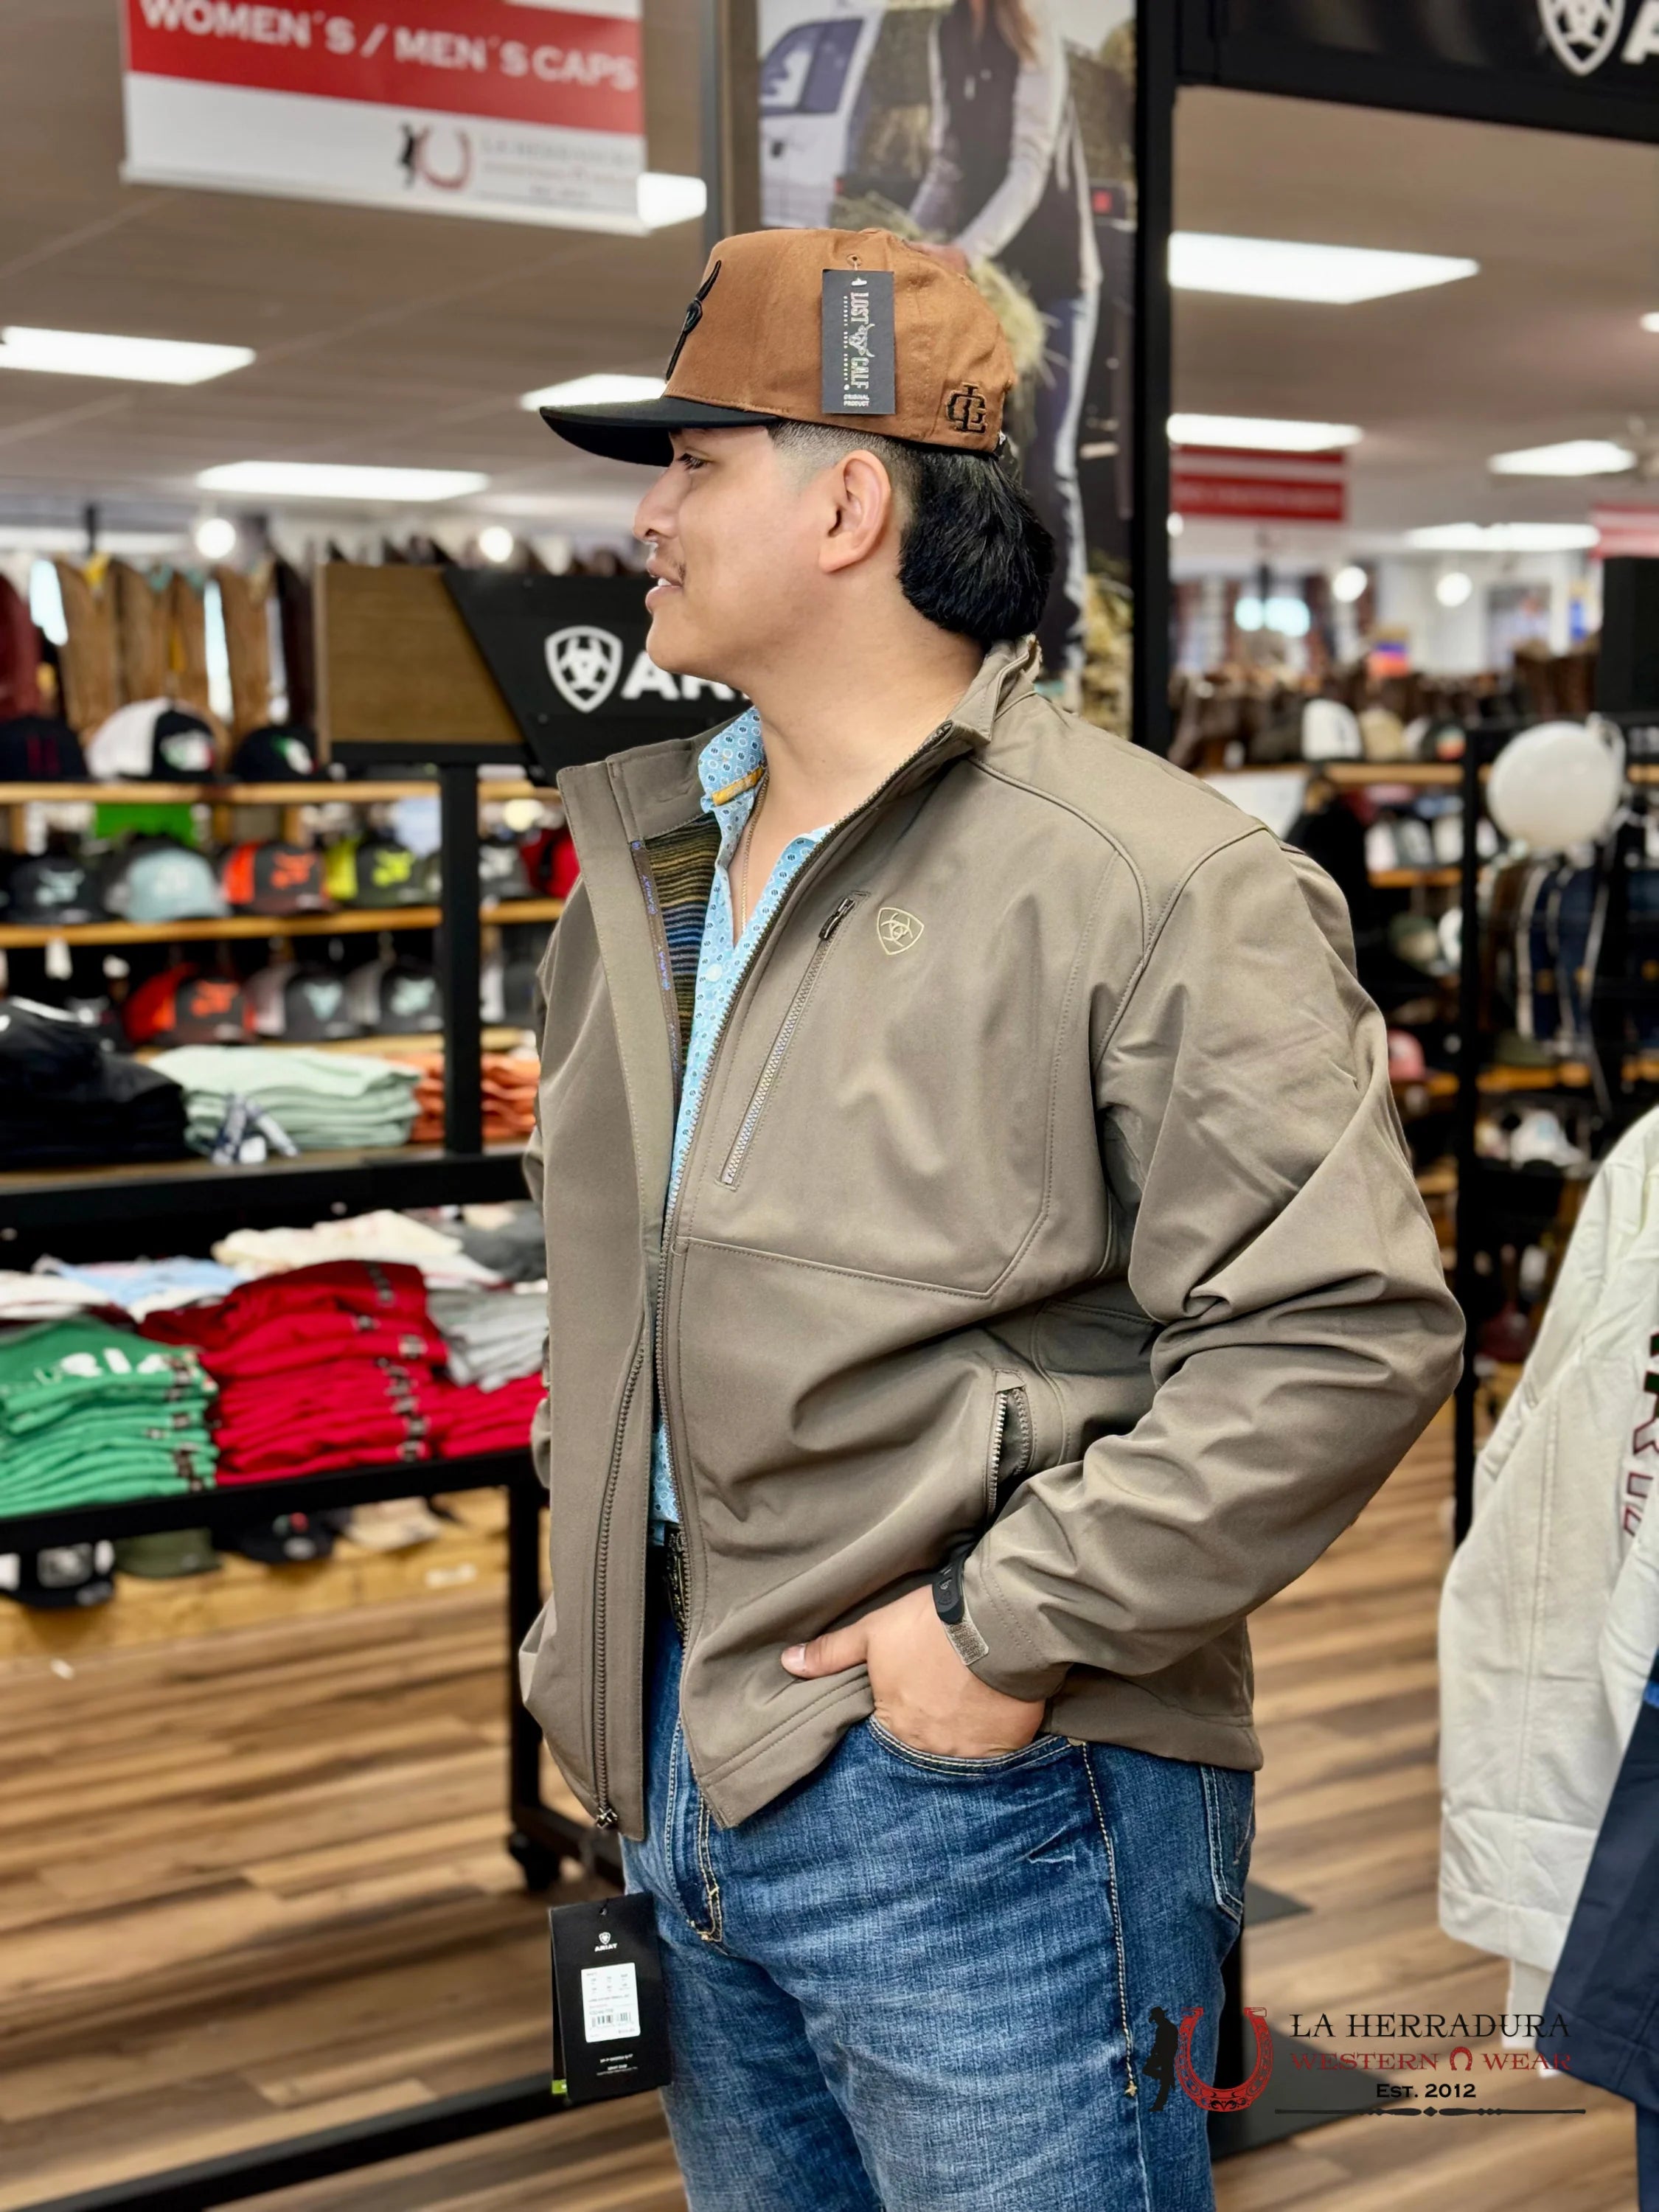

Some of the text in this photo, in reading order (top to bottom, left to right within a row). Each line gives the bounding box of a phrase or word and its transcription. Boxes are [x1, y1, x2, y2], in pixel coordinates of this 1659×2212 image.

[532, 45, 637, 91] CAPS
[851, 292, 869, 389] LOST CALF
[594, 1943, 618, 1952] ARIAT
